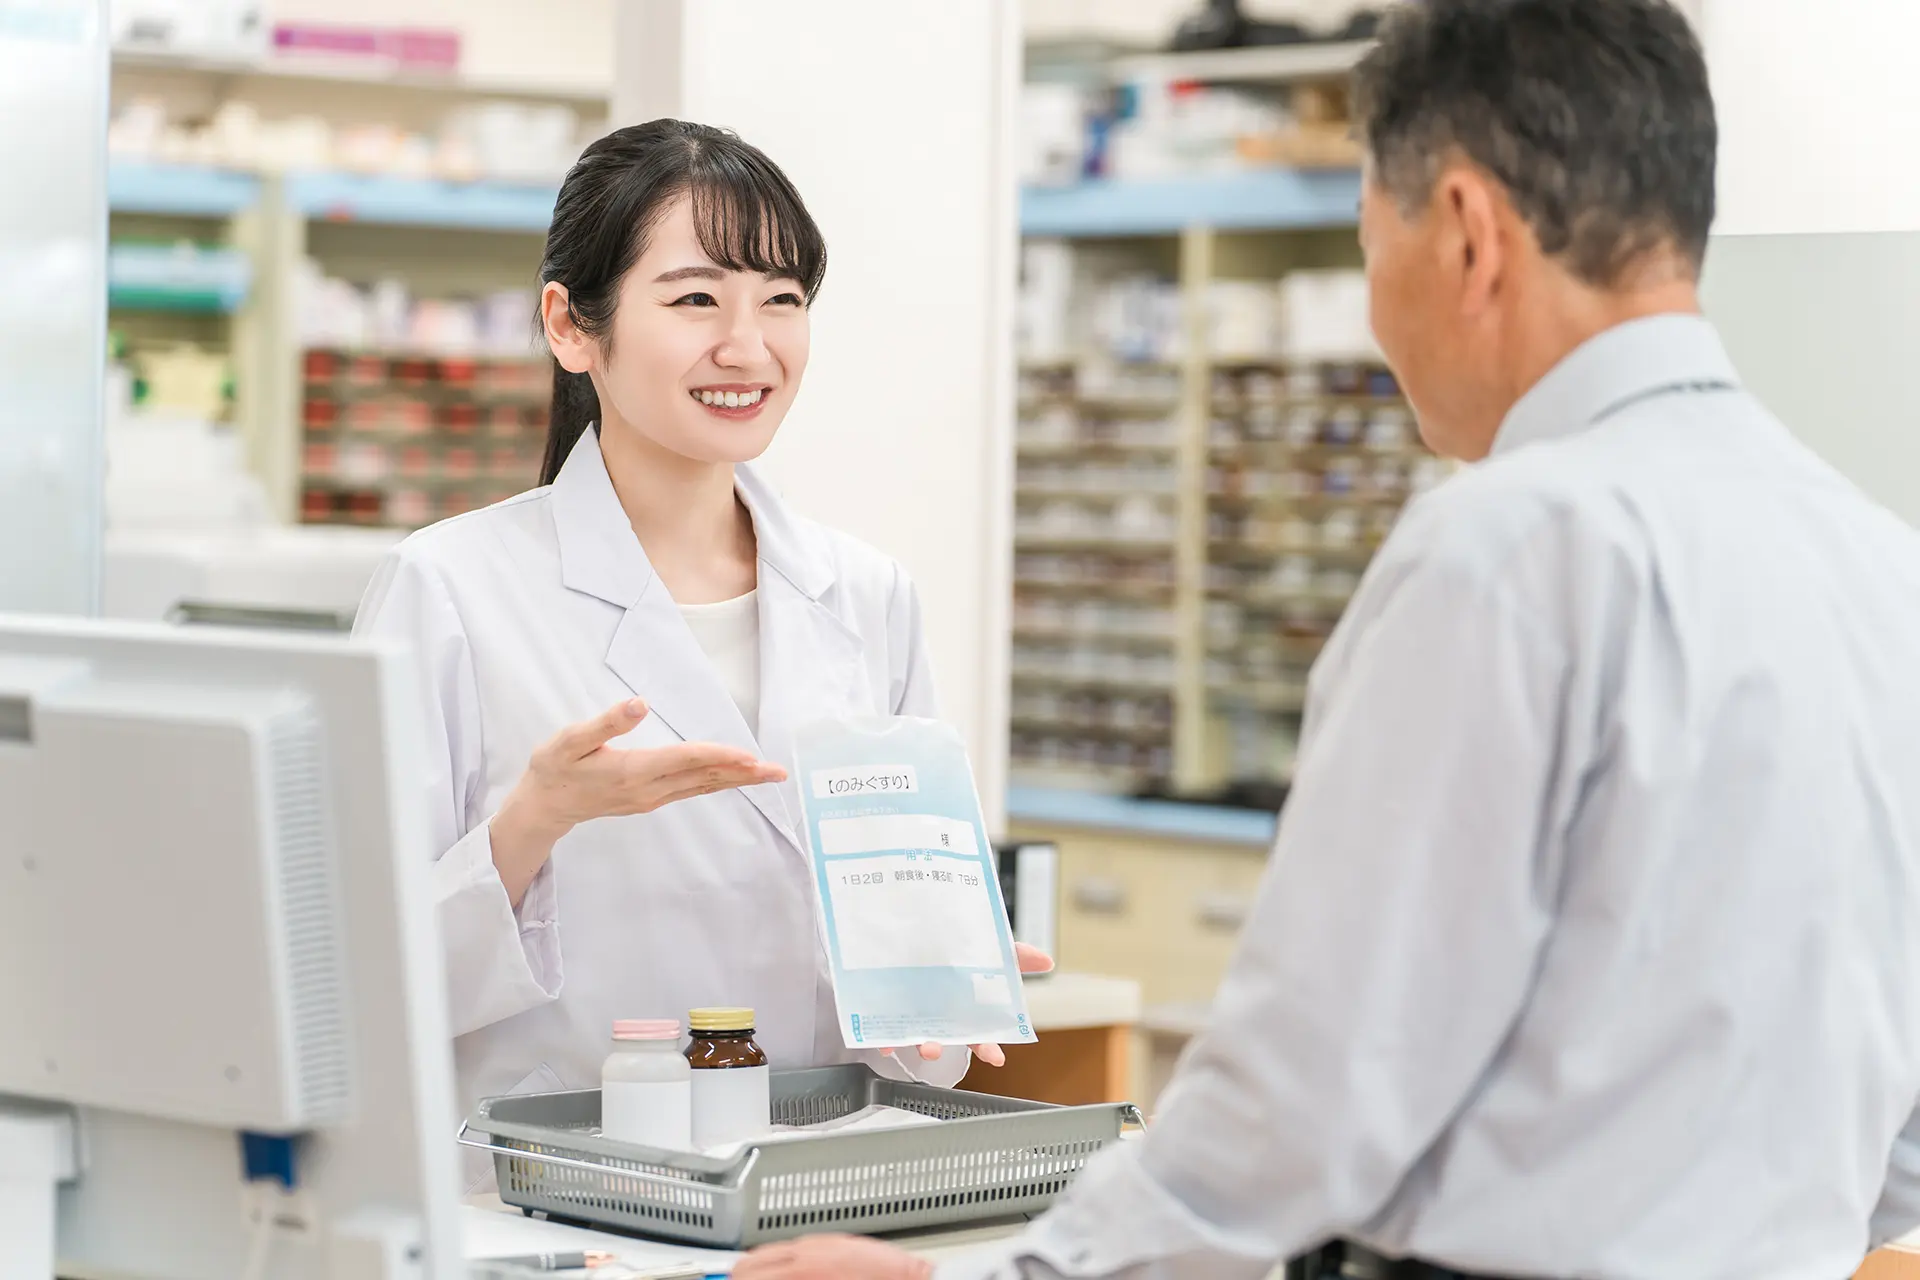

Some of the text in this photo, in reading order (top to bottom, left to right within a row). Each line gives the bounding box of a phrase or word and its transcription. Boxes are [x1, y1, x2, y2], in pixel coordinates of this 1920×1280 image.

[829, 775, 910, 794] 【のみぐすり】
[842, 872, 883, 885] 1日2回
[958, 874, 978, 886] 7日分
